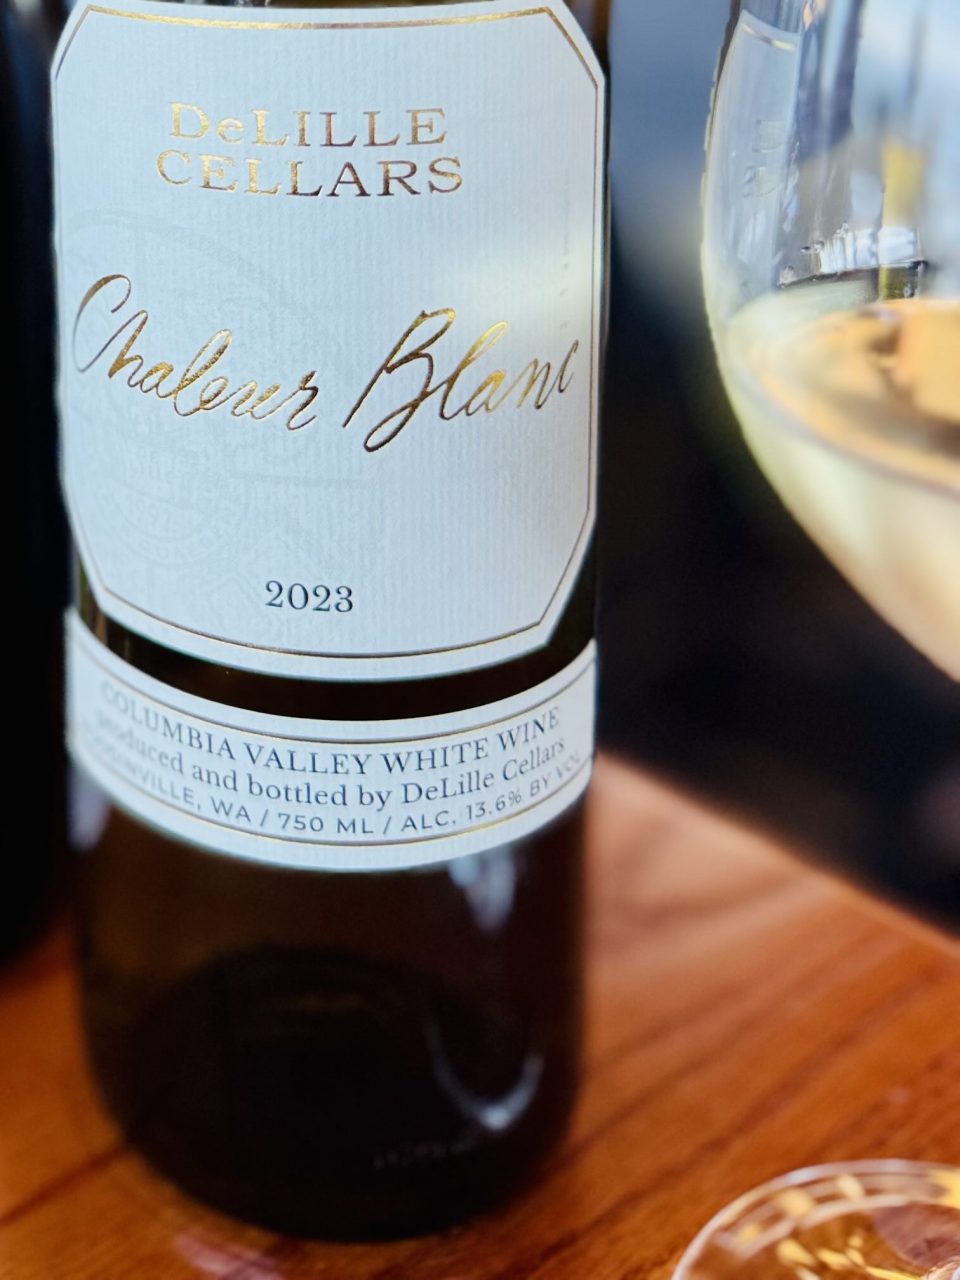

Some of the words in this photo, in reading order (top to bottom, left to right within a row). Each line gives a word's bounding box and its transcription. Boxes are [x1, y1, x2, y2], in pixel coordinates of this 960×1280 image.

[168, 101, 448, 147] DeLILLE
[155, 149, 464, 198] CELLARS
[72, 273, 320, 432] Chaleur
[342, 307, 580, 453] Blanc
[265, 579, 354, 613] 2023
[100, 681, 236, 761] COLUMBIA
[243, 742, 372, 775] VALLEY
[380, 737, 489, 774] WHITE
[496, 706, 560, 753] WINE
[192, 769, 239, 793] and
[247, 773, 348, 807] bottled
[357, 784, 393, 812] by
[401, 770, 495, 804] DeLille
[502, 737, 566, 782] Cellars
[210, 796, 252, 823] WA
[259, 808, 269, 828] /
[277, 811, 324, 833] 750
[336, 817, 374, 834] ML
[382, 815, 392, 835] /
[400, 810, 456, 832] ALC.
[465, 789, 523, 821] 13.6%
[529, 773, 551, 797] BY
